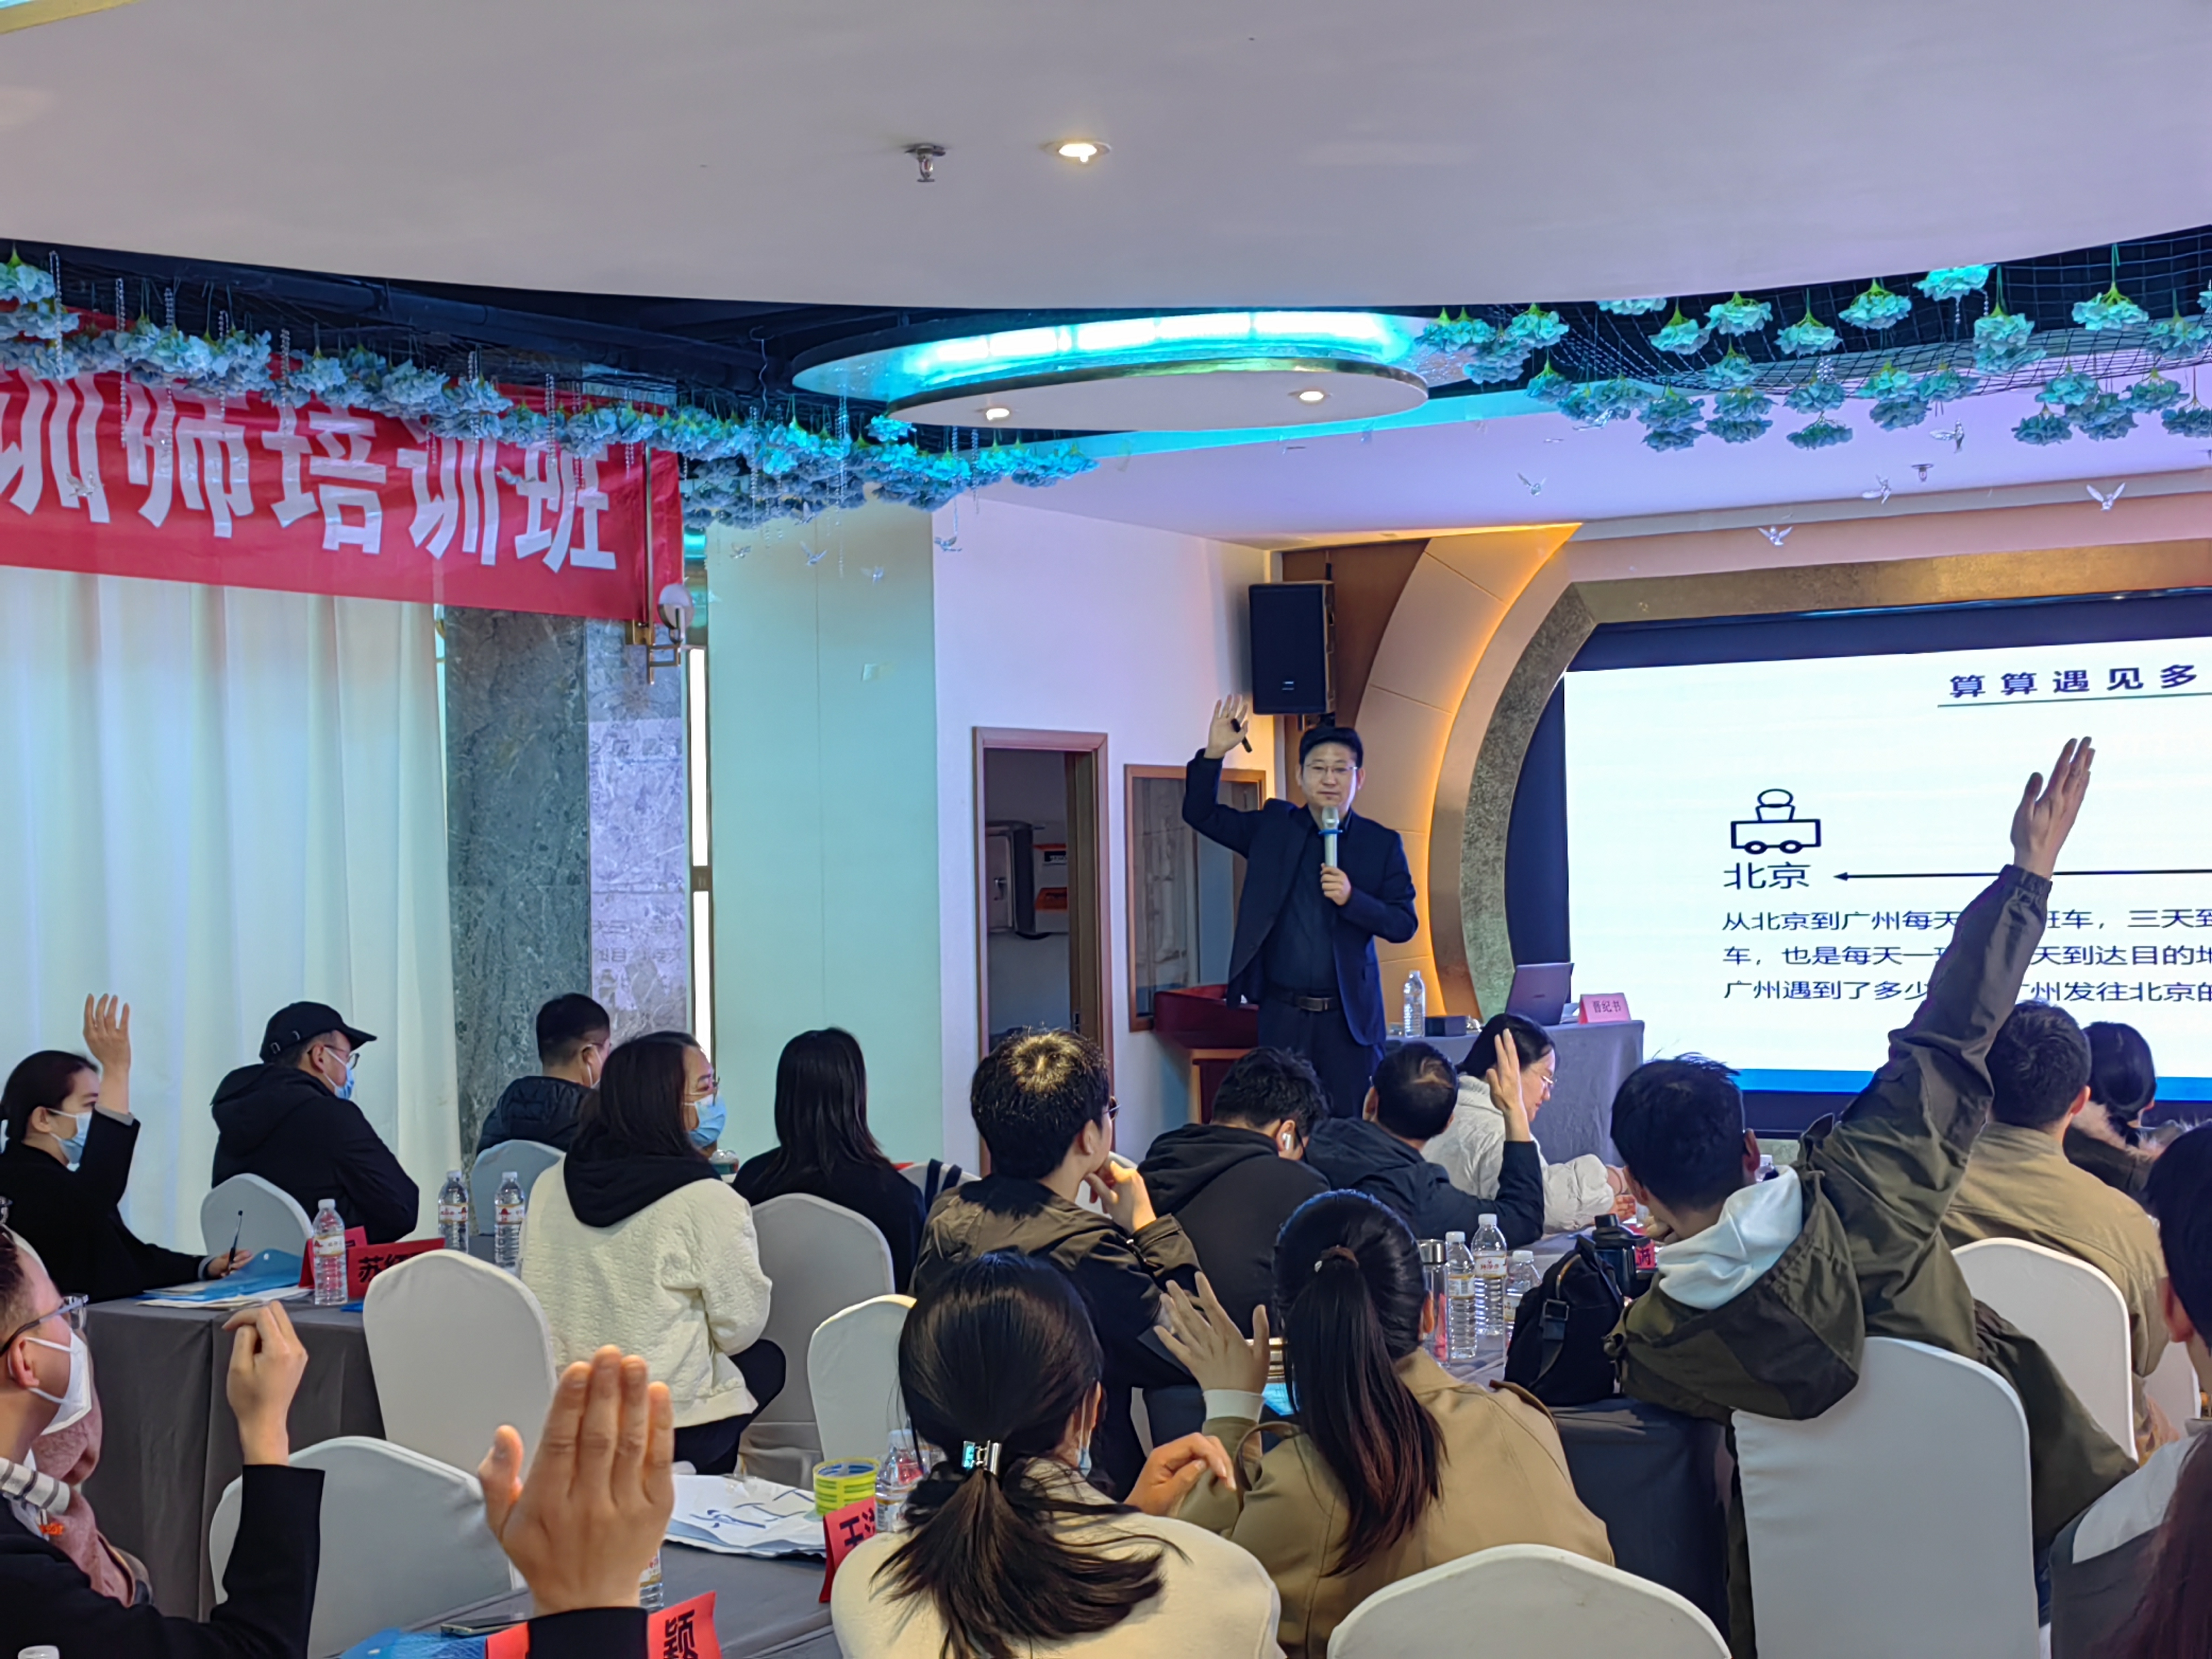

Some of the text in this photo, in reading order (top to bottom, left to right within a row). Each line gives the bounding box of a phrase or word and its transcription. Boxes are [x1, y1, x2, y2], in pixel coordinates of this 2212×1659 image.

[0, 368, 617, 574] 训师培训班
[1950, 664, 2197, 698] 算算遇见多
[1723, 862, 1811, 890] 北京
